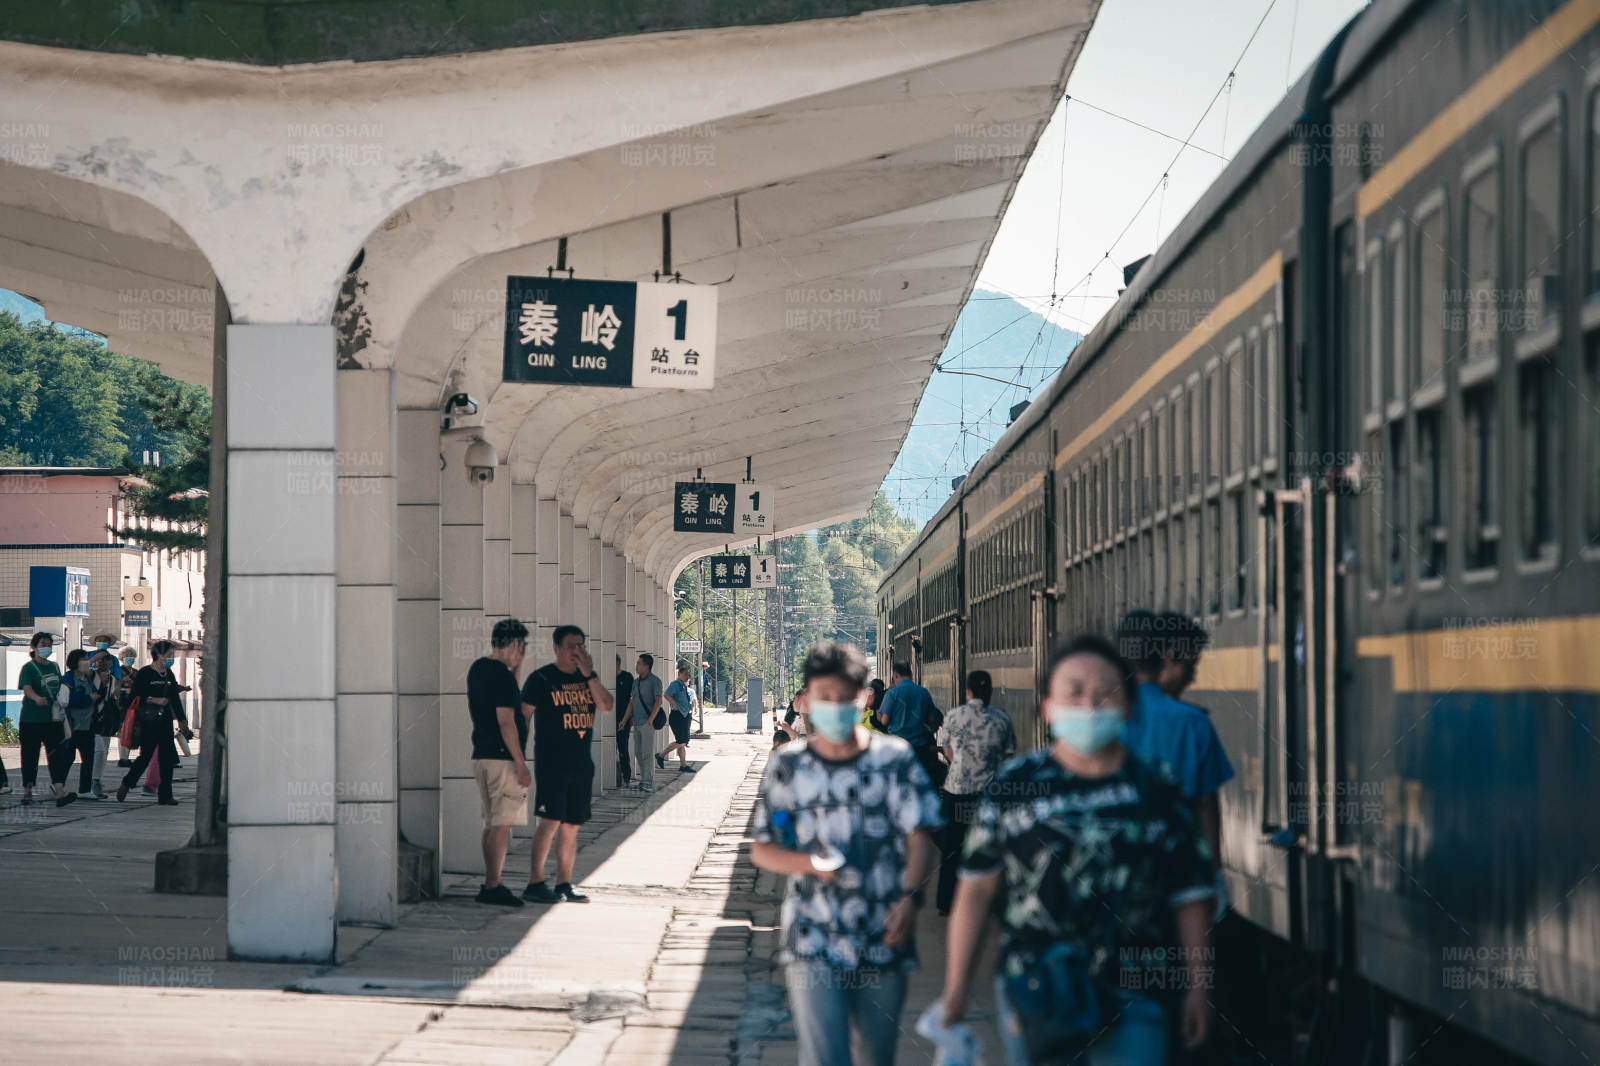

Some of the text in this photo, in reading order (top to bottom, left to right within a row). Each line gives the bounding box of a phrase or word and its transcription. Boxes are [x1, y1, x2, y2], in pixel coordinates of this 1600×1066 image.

[518, 301, 622, 351] 秦岭
[666, 299, 688, 341] 1
[527, 353, 607, 370] QIN LING
[651, 347, 700, 366] 站台
[650, 366, 699, 376] Platform
[680, 492, 729, 516] 秦岭
[749, 491, 760, 511] 1
[742, 513, 766, 522] 站台
[715, 562, 747, 578] 秦岭
[760, 559, 767, 572] 1
[551, 689, 593, 706] WORKE
[563, 713, 593, 729] ROOM
